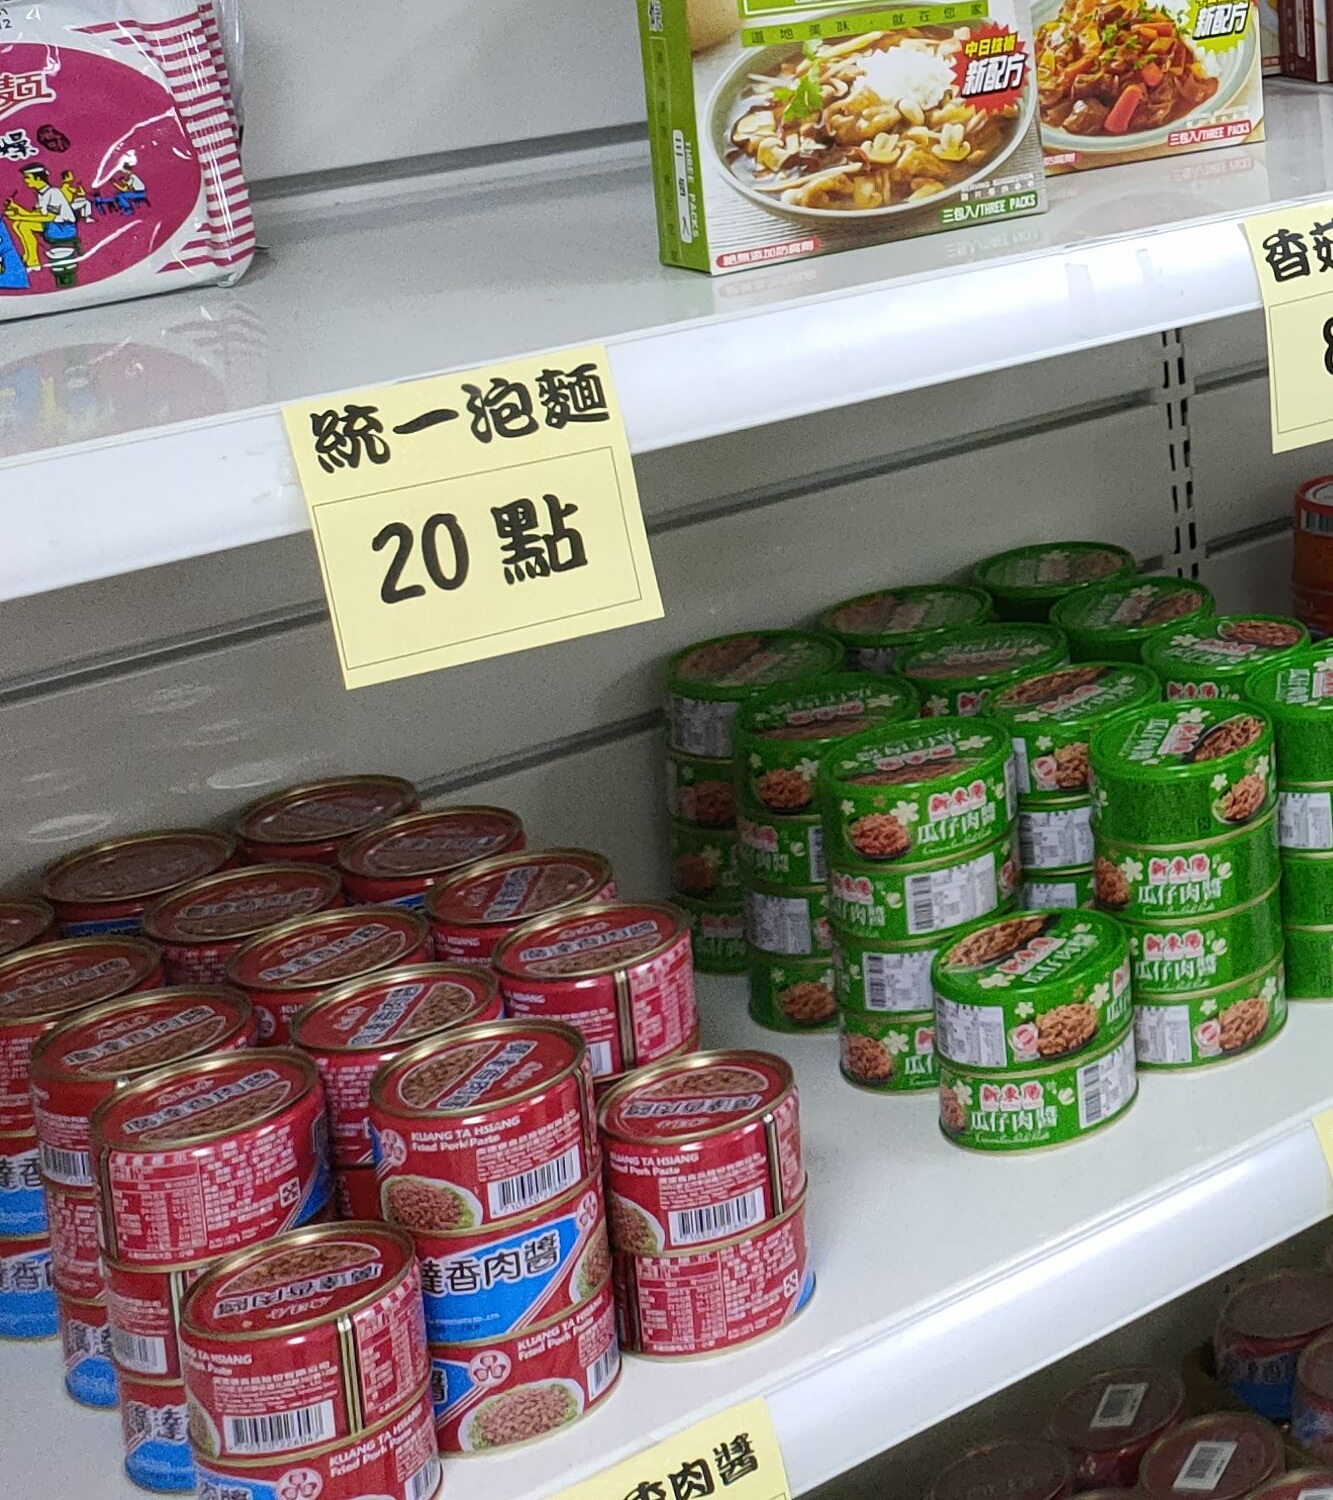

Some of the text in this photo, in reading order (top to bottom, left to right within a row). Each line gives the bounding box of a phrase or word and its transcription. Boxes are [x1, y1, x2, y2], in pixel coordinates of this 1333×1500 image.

[1192, 1, 1249, 39] 新配方
[962, 53, 1028, 98] 新配方
[1227, 123, 1250, 138] PACKS
[1009, 192, 1037, 211] PACKS
[310, 363, 611, 473] 統一泡麵
[372, 494, 588, 605] 20 點
[1149, 854, 1210, 882] 新東陽
[1144, 930, 1205, 958] 新東陽
[981, 1080, 1044, 1108] 新東陽
[411, 1115, 522, 1143] KUANG TA HSIANG
[656, 1153, 700, 1166] HSIANG
[516, 1325, 561, 1351] KUANG
[561, 1318, 577, 1337] TA
[328, 1438, 375, 1468] KUANG
[375, 1430, 392, 1448] TA
